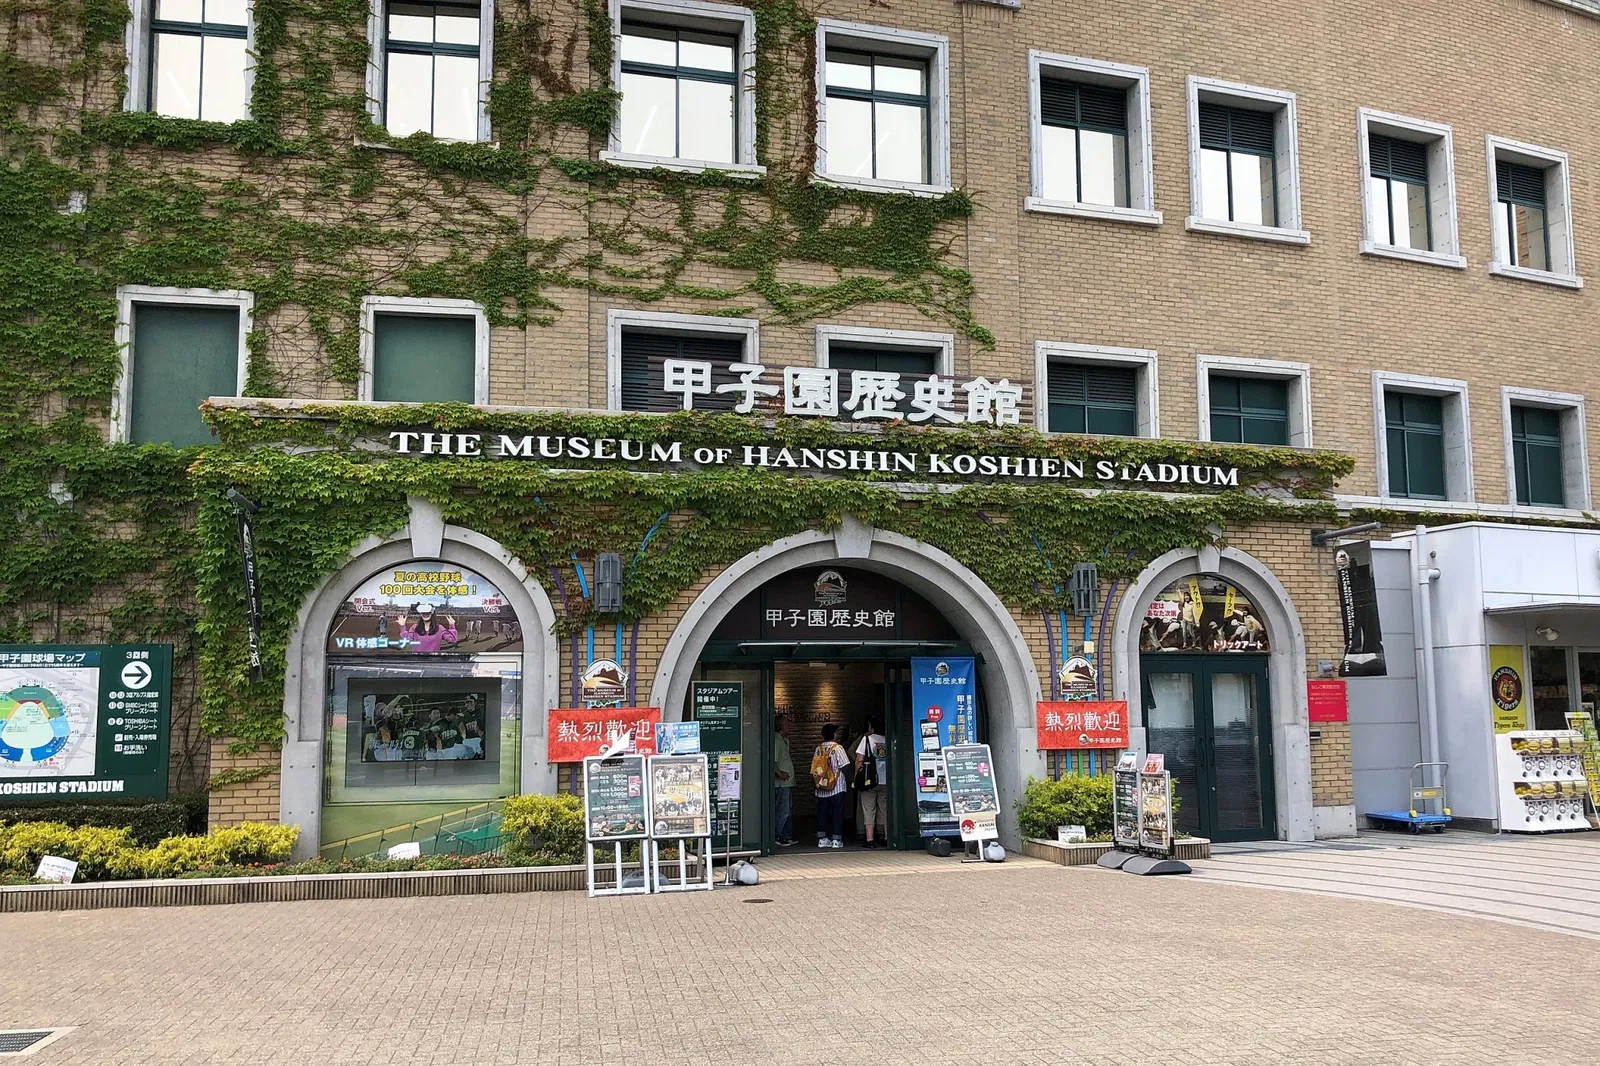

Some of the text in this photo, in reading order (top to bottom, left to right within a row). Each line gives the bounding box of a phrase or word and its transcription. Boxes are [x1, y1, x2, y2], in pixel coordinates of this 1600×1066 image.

[663, 358, 1023, 426] 甲子園歴史館
[389, 431, 1240, 486] THE MUSEUM OF HANSHIN KOSHIEN STADIUM
[394, 571, 463, 583] 夏の高校野球
[354, 597, 376, 605] 開会式
[355, 605, 375, 613] Ver.
[766, 609, 895, 628] 甲子園歴史館
[1213, 640, 1264, 649] トリックアート
[0, 653, 86, 664] 甲子園球場マップ
[920, 677, 967, 685] 甲子園歴史館
[696, 687, 739, 695] スタジアムツアー
[1496, 698, 1519, 711] Tigers
[1493, 721, 1511, 730] Tigers
[59, 780, 124, 793] STADIUM
